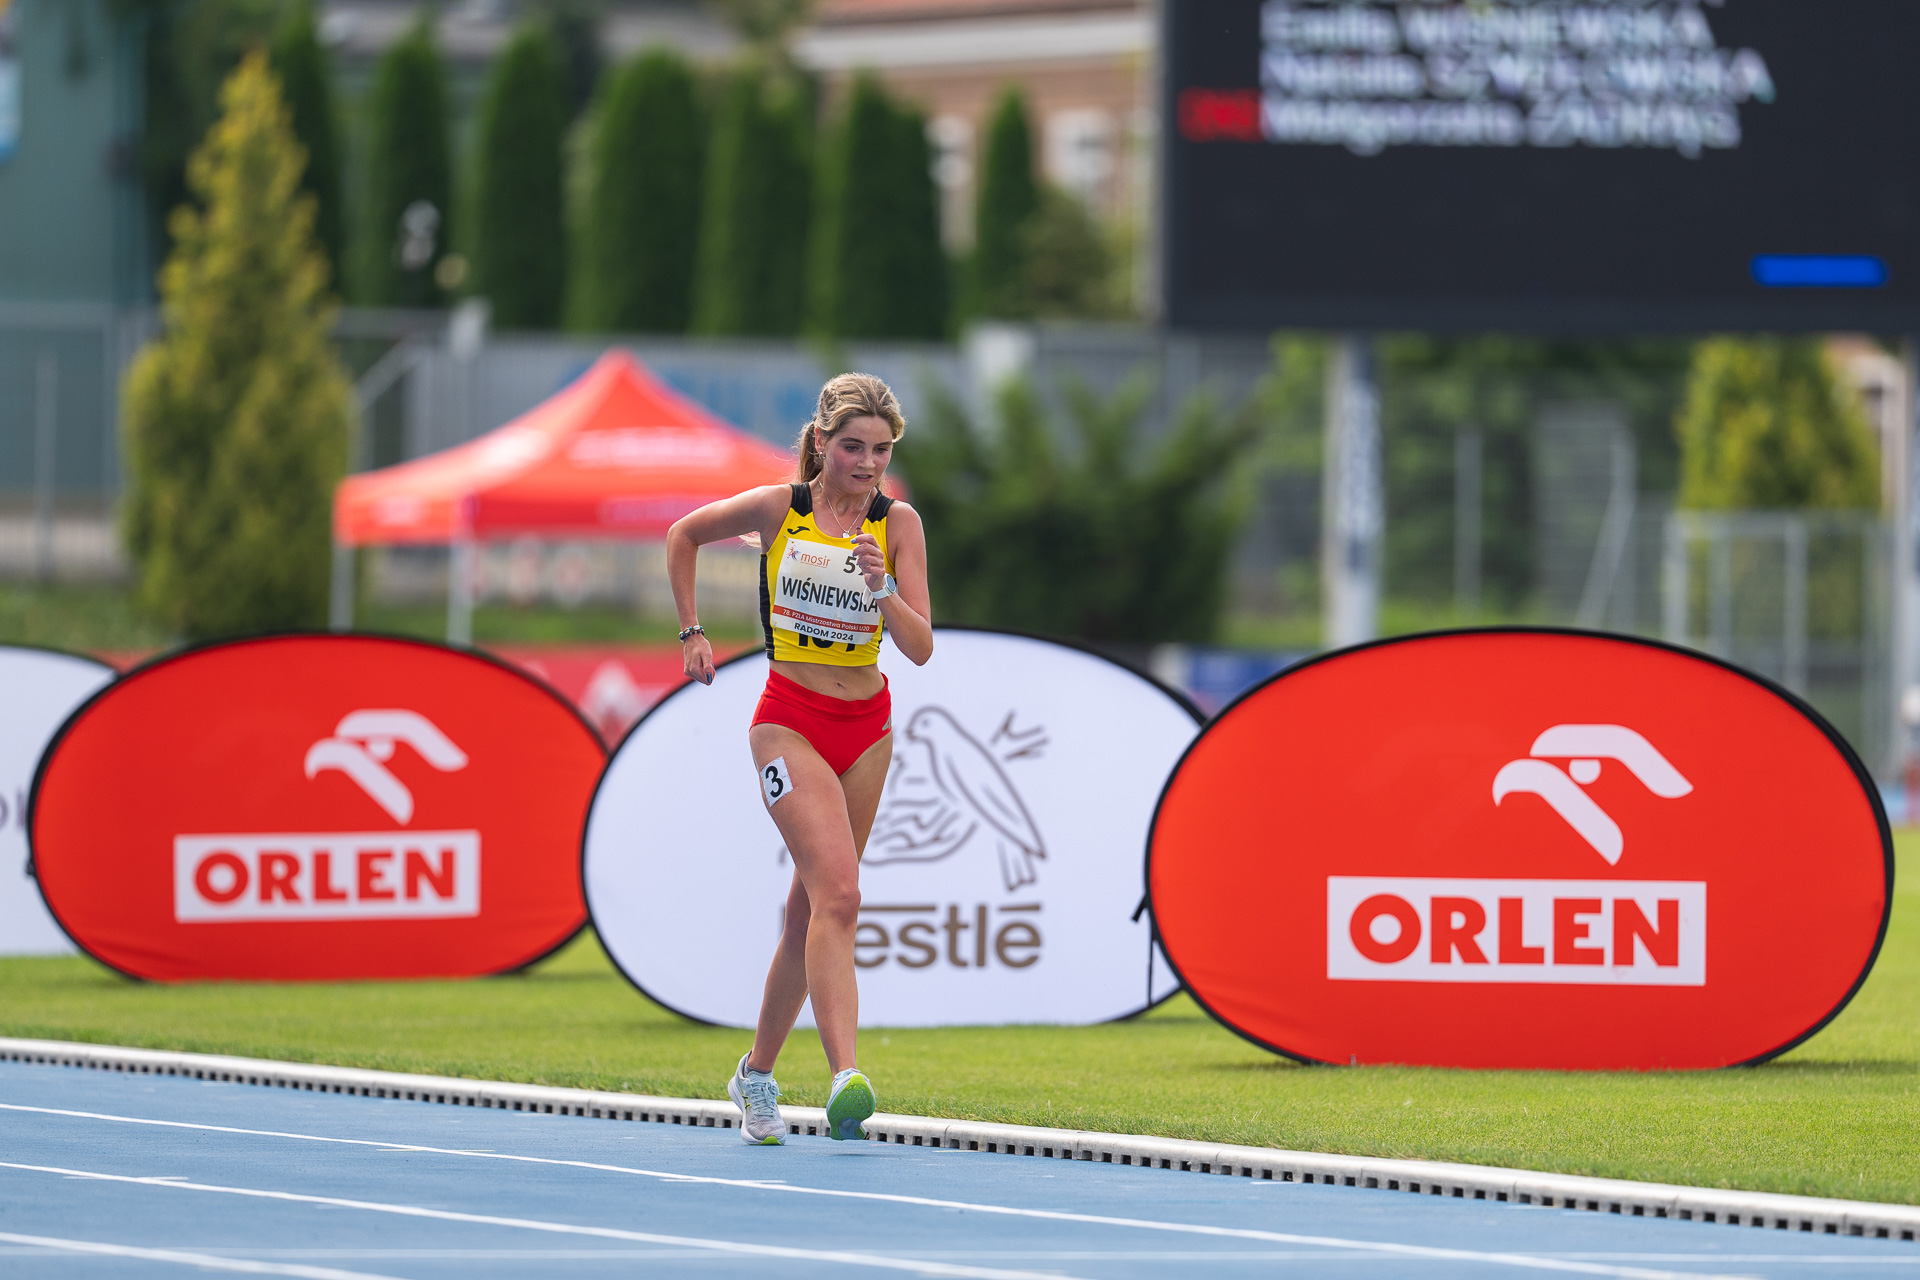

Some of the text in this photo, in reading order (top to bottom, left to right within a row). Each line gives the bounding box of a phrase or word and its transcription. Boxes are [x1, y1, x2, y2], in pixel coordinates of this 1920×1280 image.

[800, 553, 831, 567] mosir
[794, 622, 854, 641] RADOM 2024
[805, 615, 841, 628] Mistrzostwa
[841, 623, 858, 631] Polski
[765, 765, 784, 798] 3
[193, 847, 456, 904] ORLEN
[781, 902, 1042, 969] estlé
[1348, 893, 1680, 967] ORLEN
